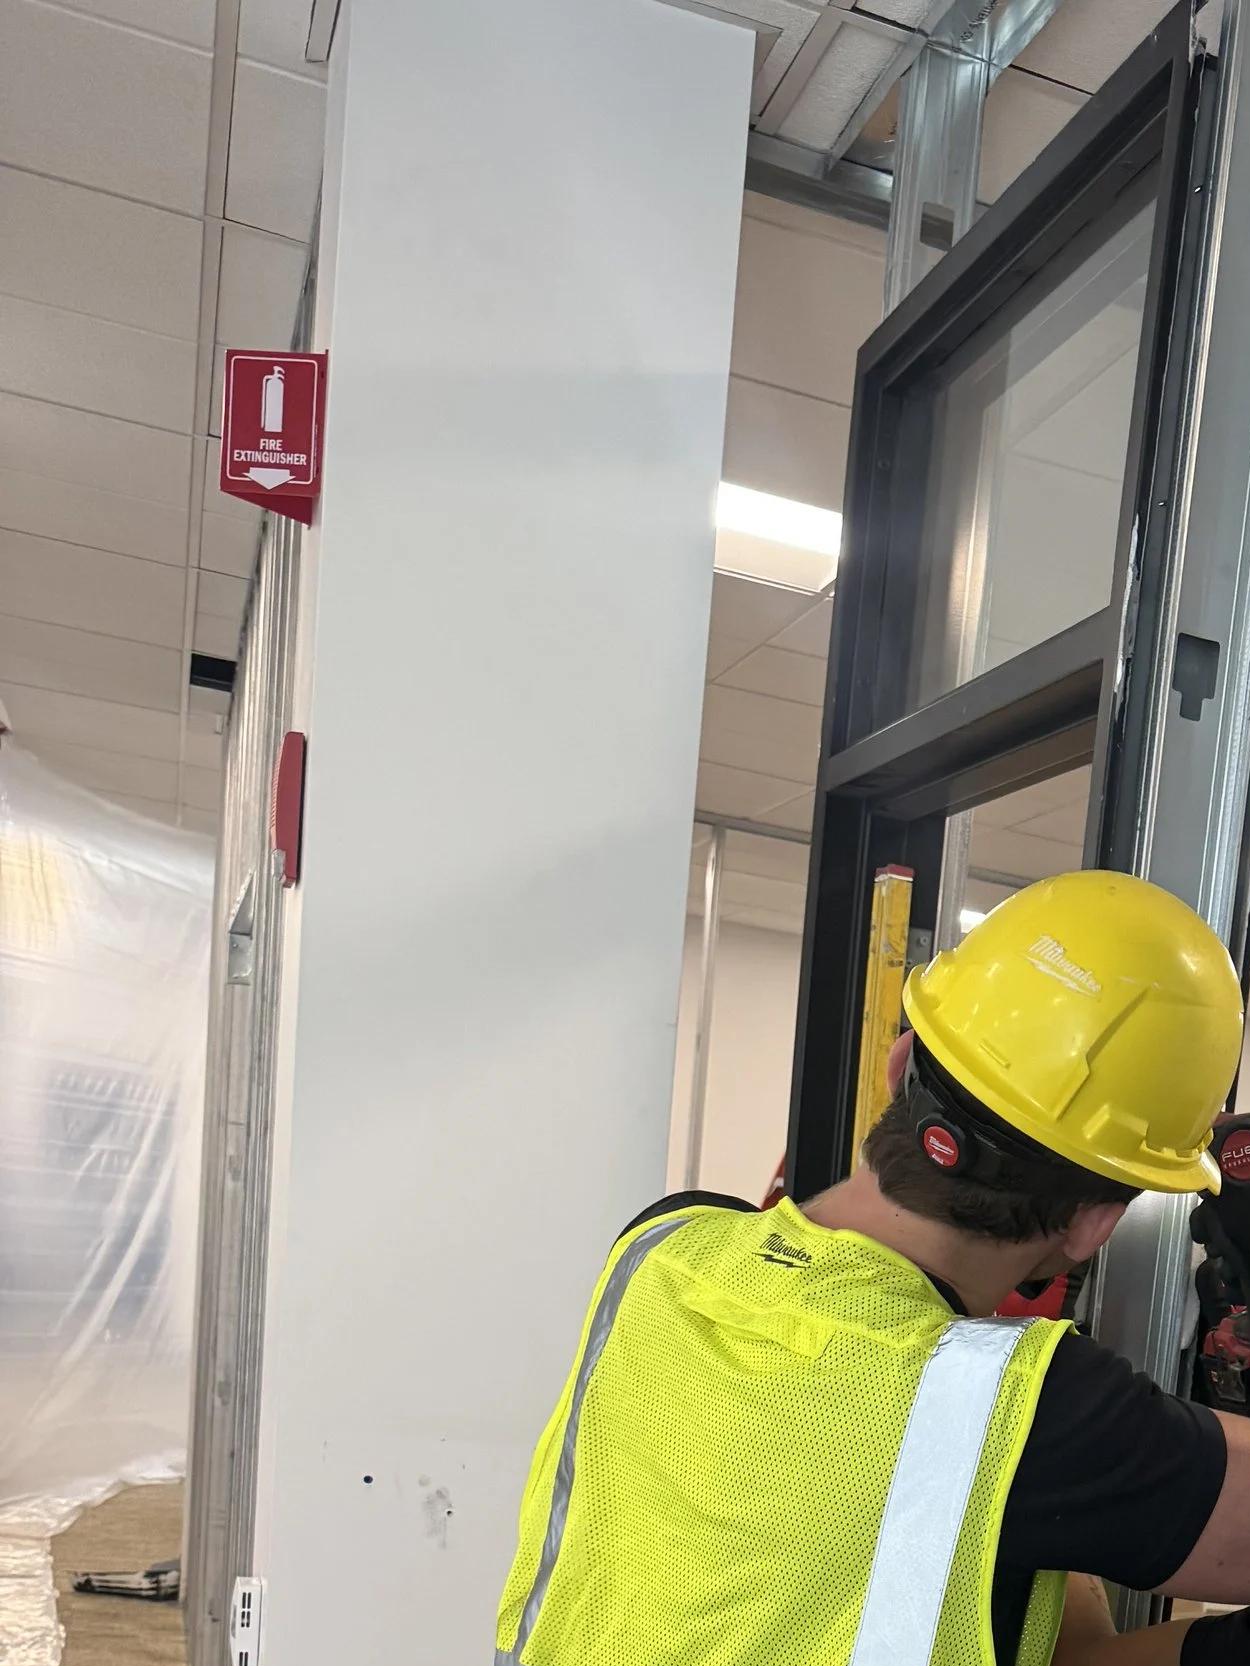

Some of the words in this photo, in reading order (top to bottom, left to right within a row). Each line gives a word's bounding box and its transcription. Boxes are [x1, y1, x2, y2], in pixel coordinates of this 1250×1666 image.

[260, 438, 283, 451] FIRE
[233, 449, 307, 466] EXTINGUISHER
[1028, 935, 1102, 992] Milwaukee
[759, 1232, 812, 1264] Milwaukee
